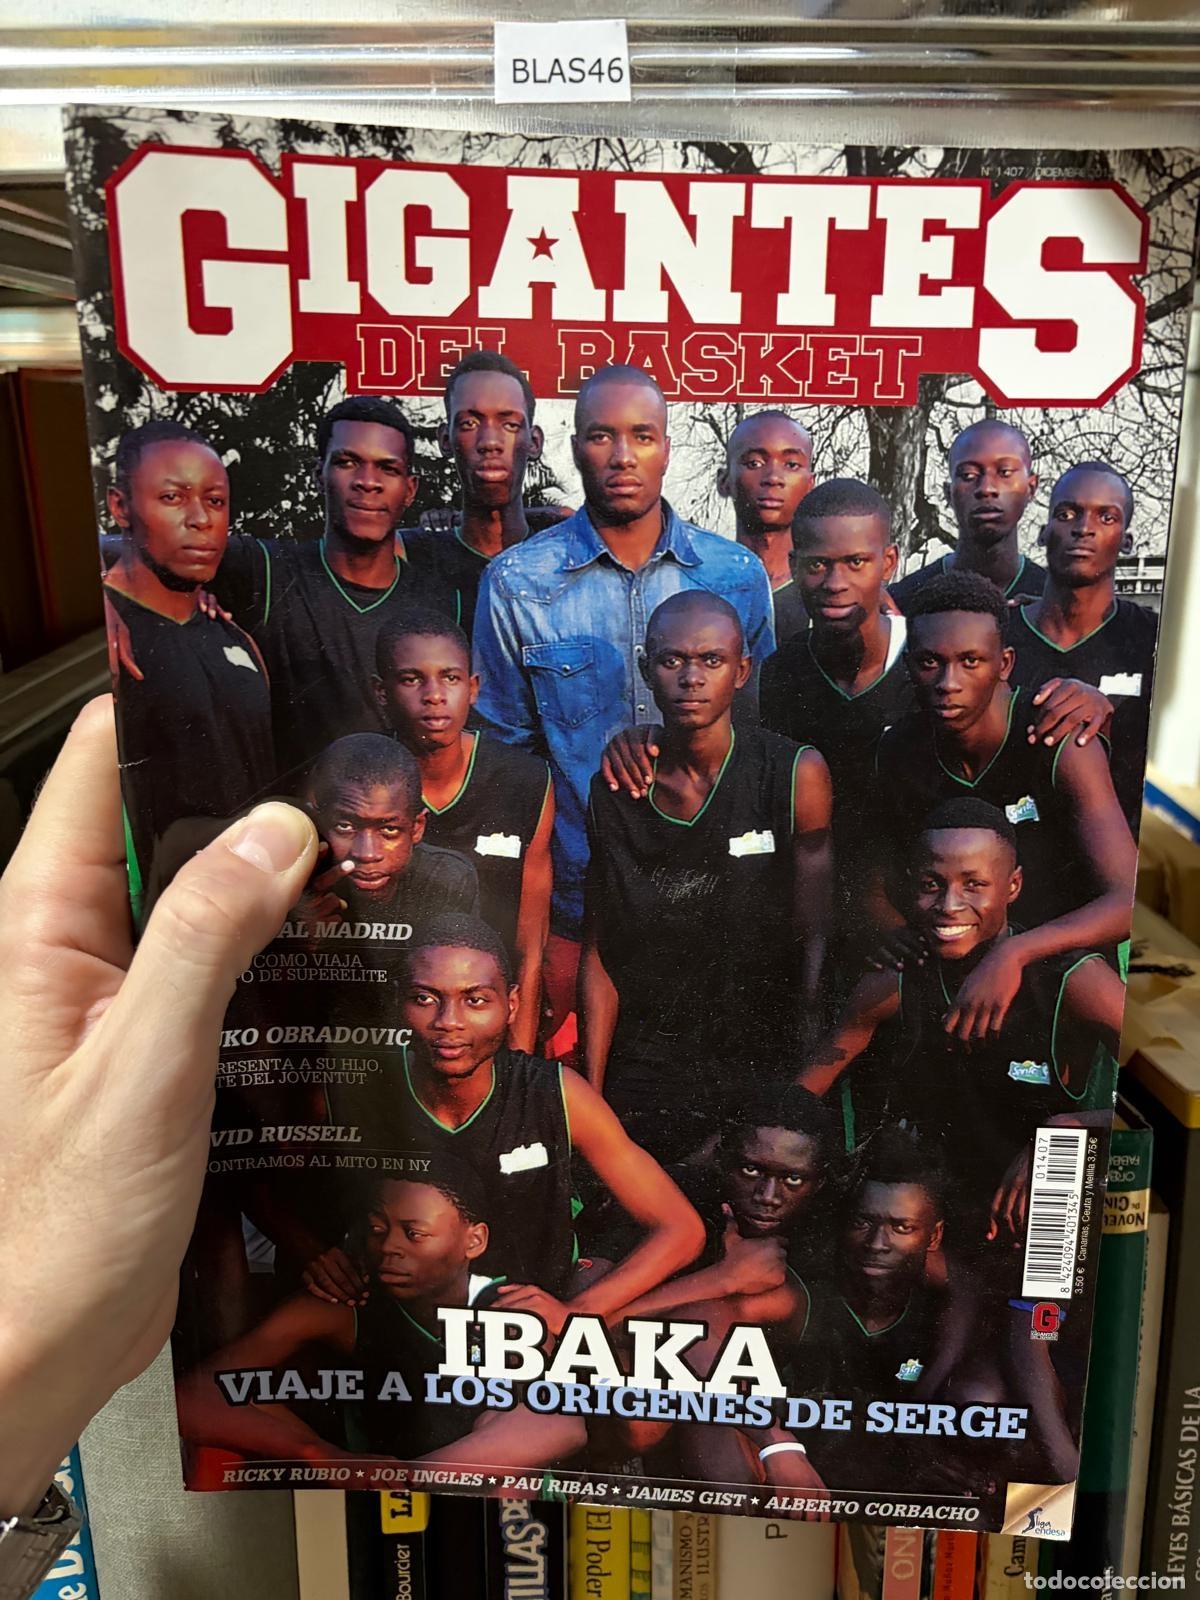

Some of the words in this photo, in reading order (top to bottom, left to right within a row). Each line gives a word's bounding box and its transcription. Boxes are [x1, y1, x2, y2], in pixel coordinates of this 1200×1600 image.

[510, 57, 624, 85] BLAS46
[115, 151, 1142, 400] GIGANTES
[557, 329, 922, 399] BASKET
[313, 922, 413, 941] MADRID
[314, 953, 365, 968] VIAJA
[259, 969, 283, 982] DE
[286, 968, 388, 983] SUPERELITE
[266, 1026, 413, 1047] OBRADOVIC
[299, 1057, 313, 1071] A
[316, 1057, 337, 1071] SU
[241, 1072, 275, 1087] DEL
[278, 1071, 368, 1085] JOVENTUT
[259, 1126, 363, 1143] RUSSELL
[308, 1155, 332, 1168] AL
[335, 1155, 378, 1169] MITO
[382, 1158, 404, 1170] EN
[409, 1159, 432, 1172] NY
[1036, 1137, 1048, 1180] 01407
[1084, 1161, 1096, 1190] Melilla
[1082, 1201, 1091, 1222] Ceuta
[1032, 1302, 1060, 1332] G
[437, 1307, 787, 1398] IBAKA
[219, 1369, 364, 1402] VIAJE
[377, 1371, 412, 1402] A
[424, 1373, 513, 1409] LOS
[527, 1377, 773, 1426] ORÍGENES
[785, 1397, 852, 1431] DE
[866, 1401, 1028, 1439] SERGE
[1180, 1415, 1200, 1442] DE
[222, 1468, 286, 1483] RICKY
[288, 1467, 350, 1482] RUBIO
[370, 1468, 408, 1482] JOE
[412, 1469, 485, 1486] INGLES
[502, 1476, 544, 1491] PAU
[547, 1478, 608, 1496] RIBAS
[626, 1485, 694, 1504] JAMES
[698, 1491, 748, 1507] GIST
[765, 1496, 860, 1515] ALBERTO
[864, 1501, 980, 1522] CORBACHO
[1168, 1447, 1198, 1526] BÁSICAS
[586, 1510, 613, 1530] El
[586, 1539, 613, 1598] Poder
